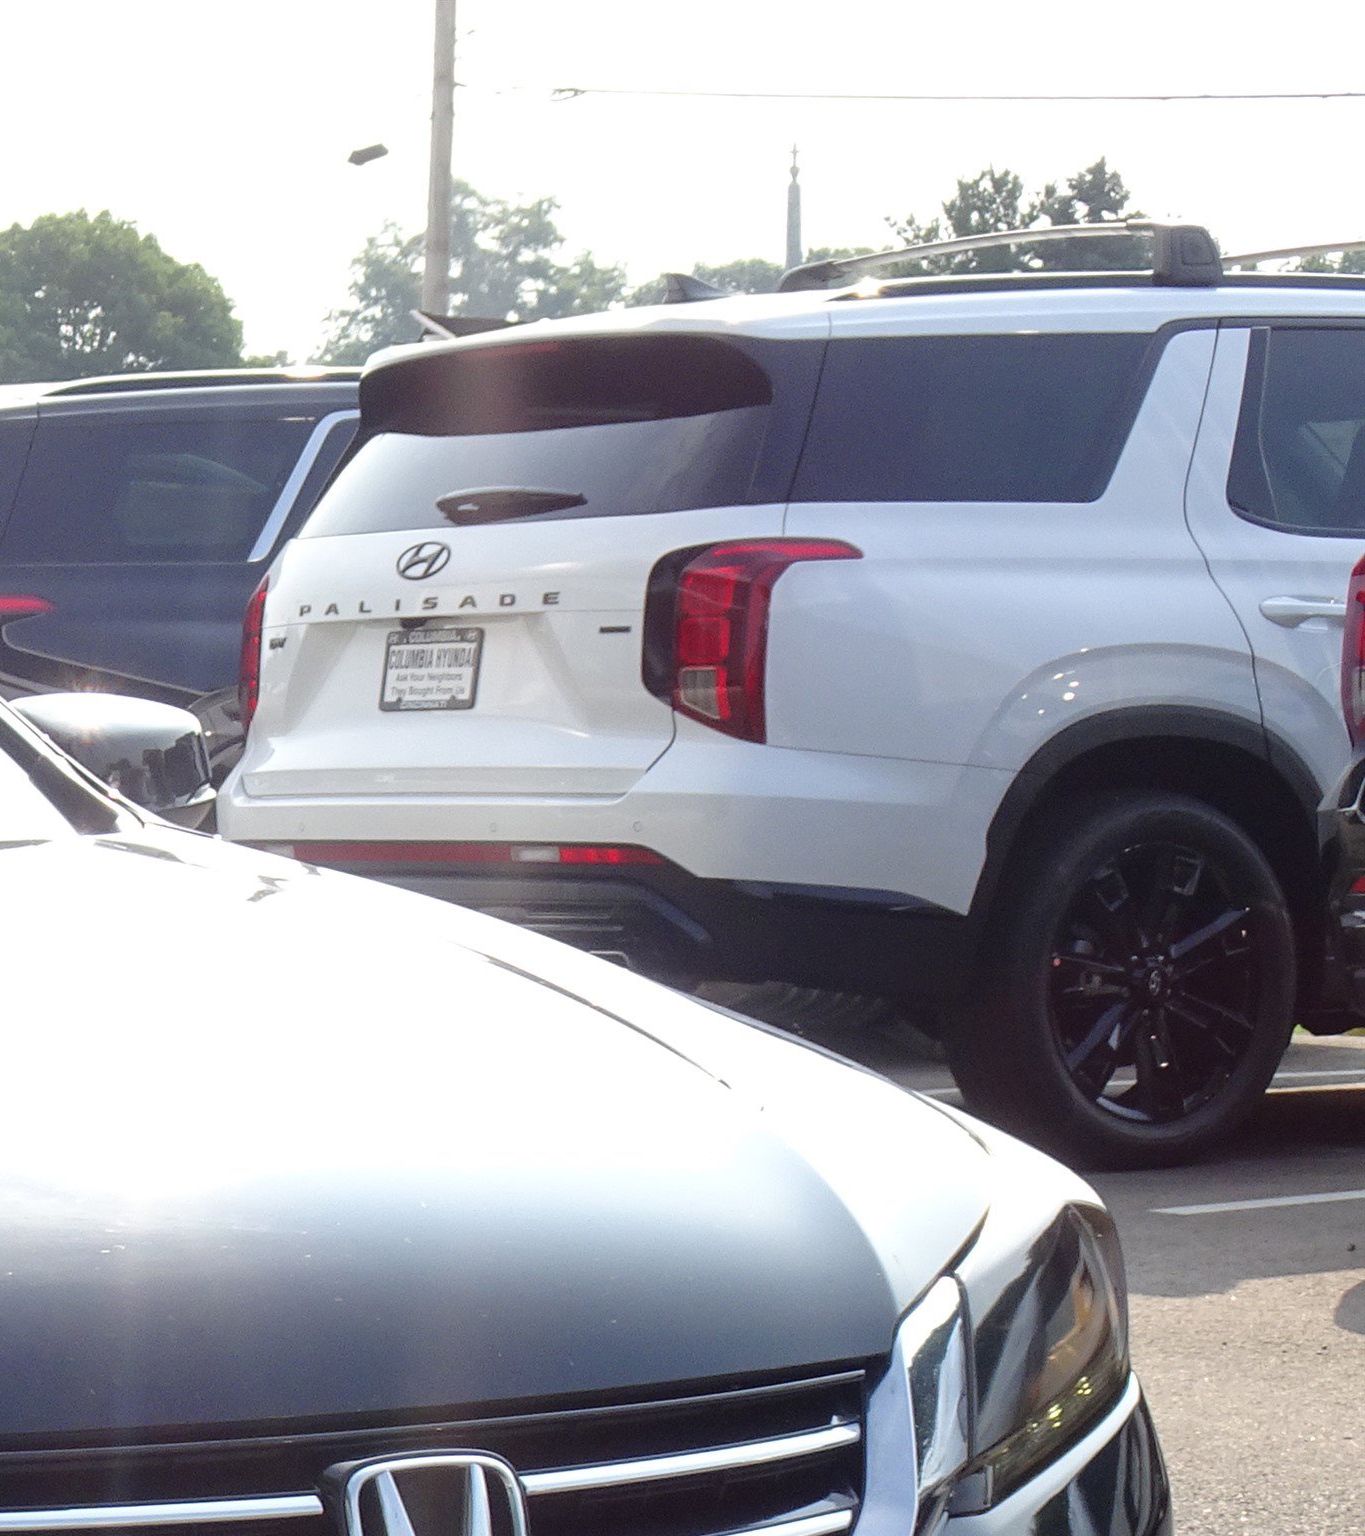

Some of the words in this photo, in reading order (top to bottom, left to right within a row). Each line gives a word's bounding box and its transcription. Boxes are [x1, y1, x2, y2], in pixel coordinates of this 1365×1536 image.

[299, 591, 560, 616] PALISADE
[389, 648, 434, 670] COLUMBIA
[410, 672, 426, 681] Your
[427, 673, 463, 683] Neighbors
[409, 686, 434, 697] Bought
[436, 686, 453, 695] From
